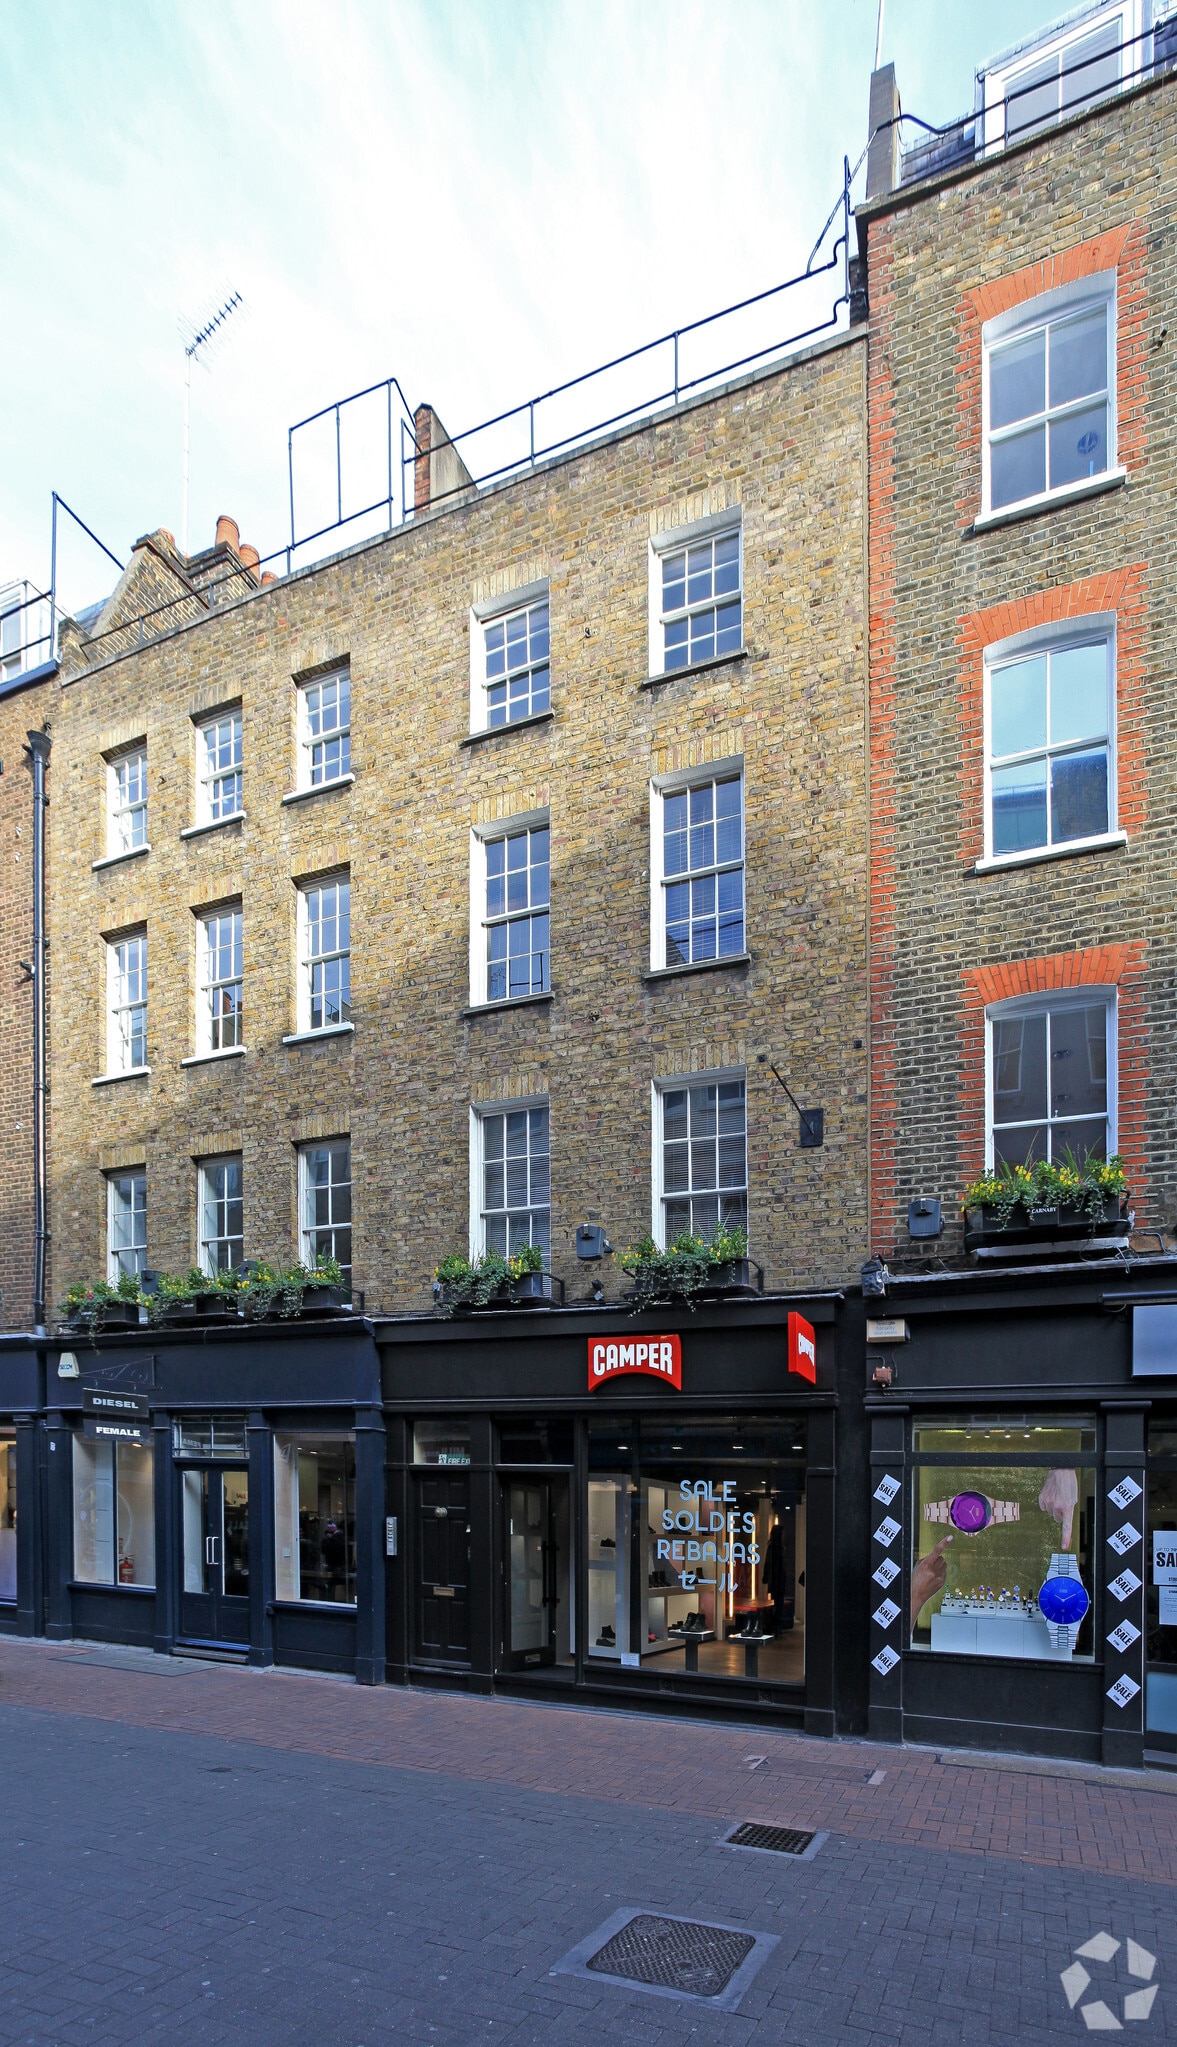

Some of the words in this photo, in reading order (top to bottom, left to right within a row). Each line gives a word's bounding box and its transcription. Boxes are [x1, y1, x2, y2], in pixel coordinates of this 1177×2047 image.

[1031, 1206, 1057, 1214] CARNABY
[593, 1342, 673, 1376] CAMPER
[92, 1397, 139, 1409] DIESEL
[95, 1426, 141, 1437] FEMALE
[680, 1480, 737, 1502] SALE
[879, 1483, 895, 1498] SALE
[1115, 1484, 1133, 1502] SALE
[662, 1509, 755, 1533] SOLDES
[879, 1524, 895, 1540] SALE
[1115, 1530, 1133, 1548] SALE
[657, 1539, 761, 1565] REBAJAS
[1156, 1552, 1177, 1567] SA
[678, 1569, 738, 1593] セール
[878, 1566, 894, 1581] SALE
[1115, 1576, 1133, 1595] SALE
[878, 1606, 894, 1622] SALE
[1114, 1627, 1132, 1645] SALE
[877, 1653, 893, 1669] SALE
[1114, 1683, 1132, 1700] SALE
